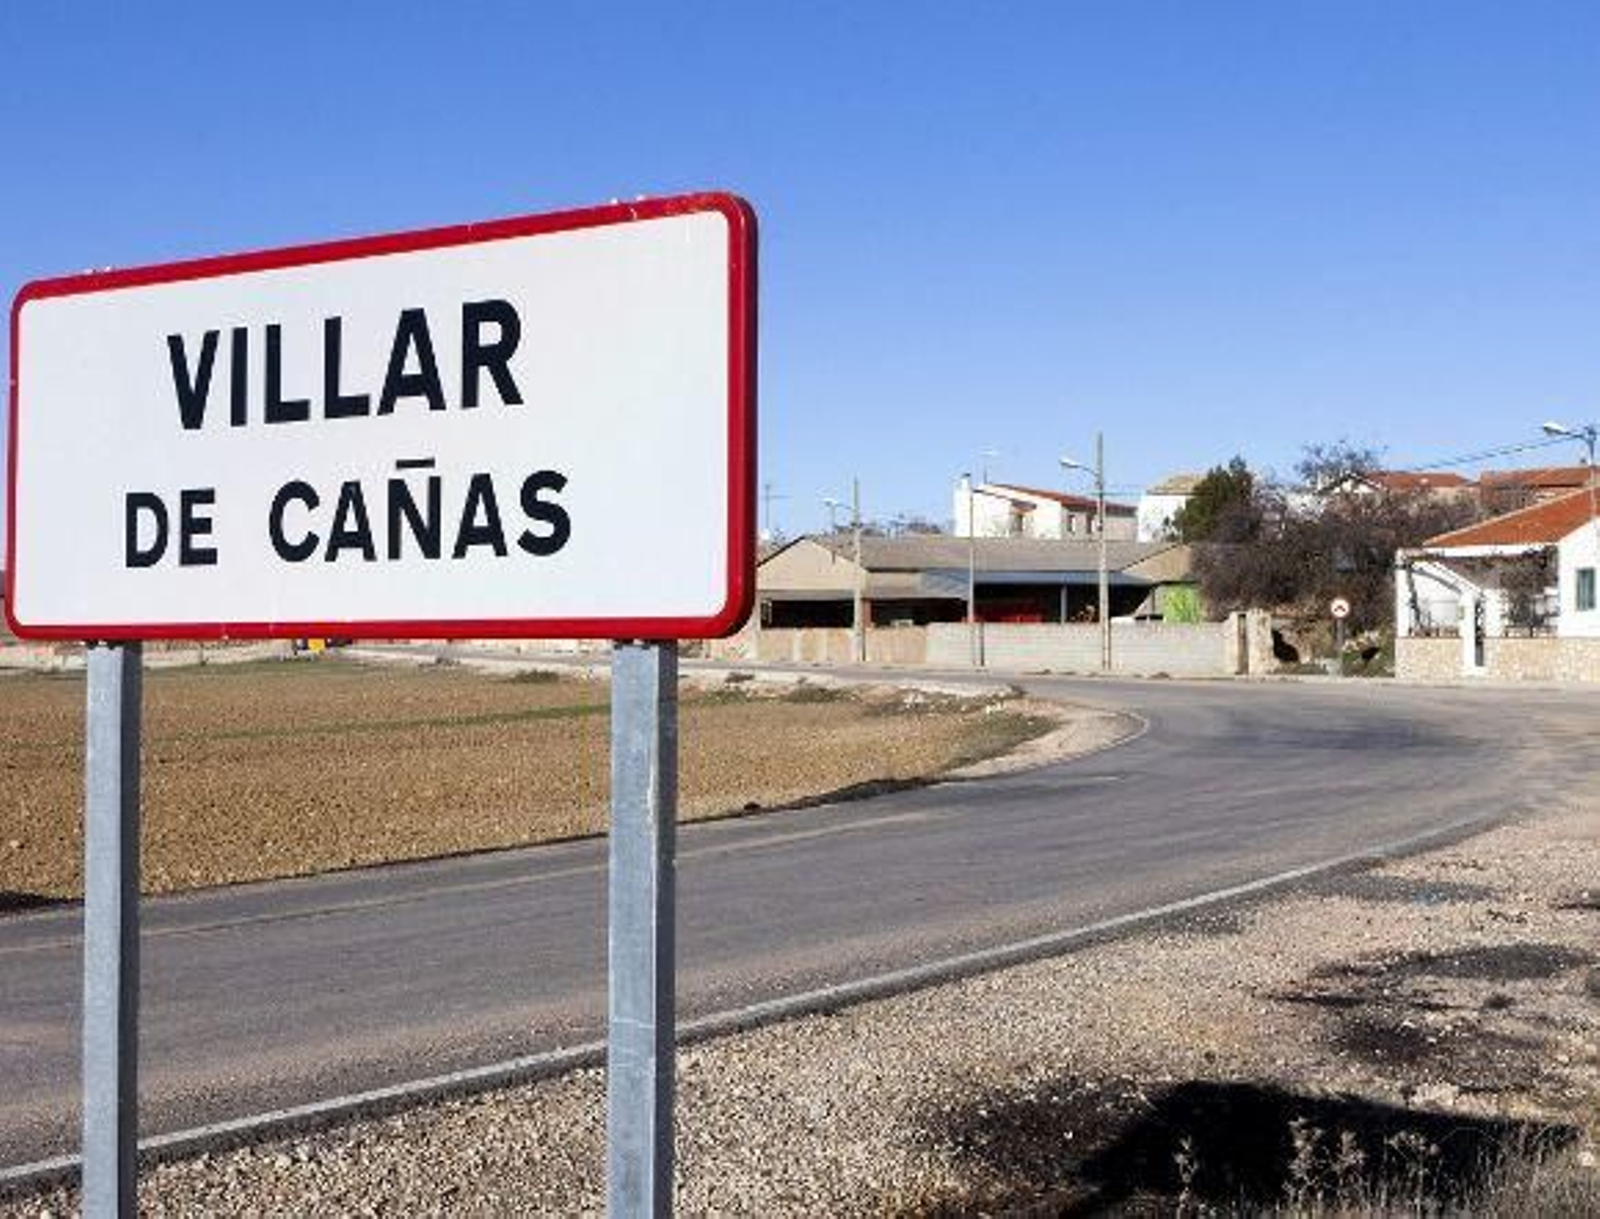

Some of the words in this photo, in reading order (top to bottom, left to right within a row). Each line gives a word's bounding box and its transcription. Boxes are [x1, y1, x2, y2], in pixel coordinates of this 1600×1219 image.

[167, 299, 524, 430] VILLAR
[125, 488, 218, 568] DE
[269, 458, 571, 563] CAÑAS
